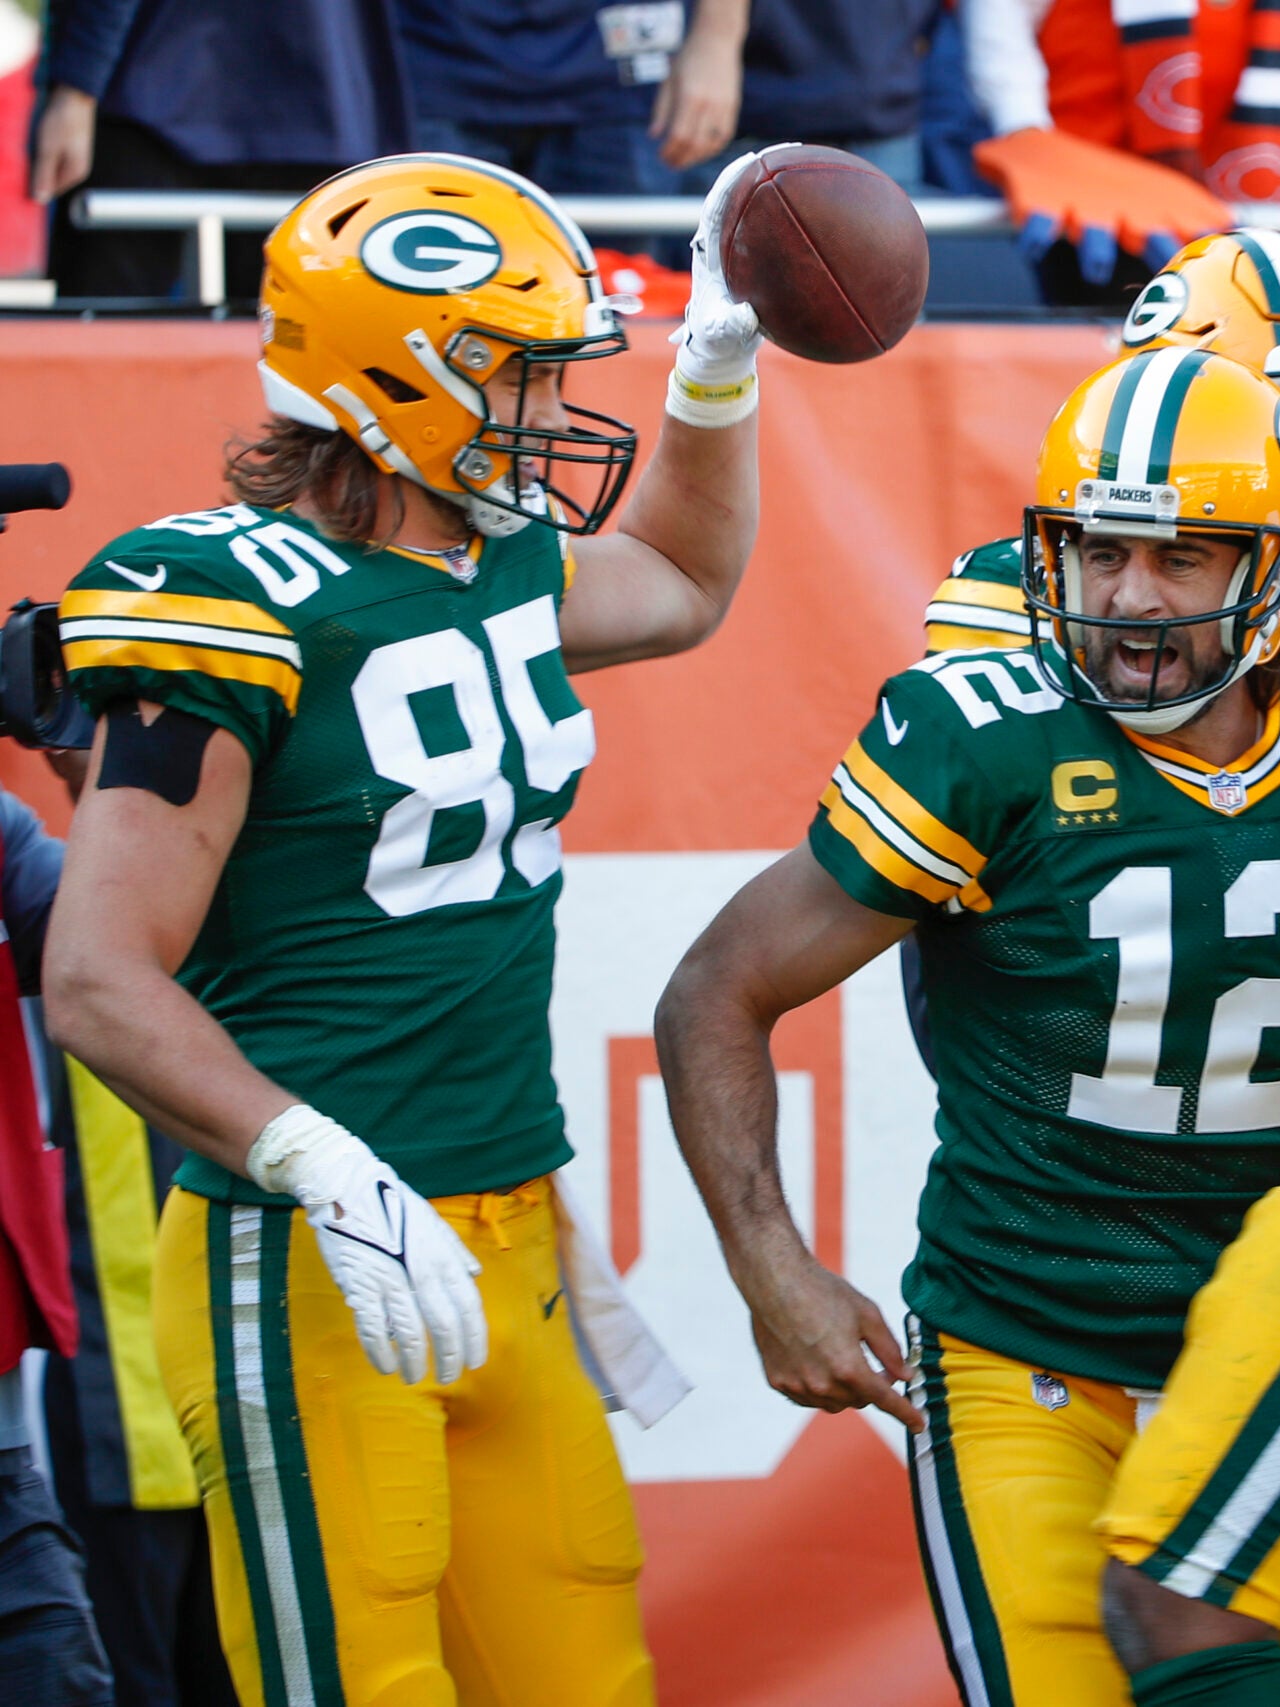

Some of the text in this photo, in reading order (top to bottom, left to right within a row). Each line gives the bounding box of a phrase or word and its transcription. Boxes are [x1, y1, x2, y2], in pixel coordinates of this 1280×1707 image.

[361, 212, 501, 289] G
[1122, 273, 1188, 343] G
[1108, 487, 1153, 504] PACKERS
[350, 594, 597, 918] 85
[1051, 759, 1119, 813] C
[1213, 786, 1243, 805] NFL
